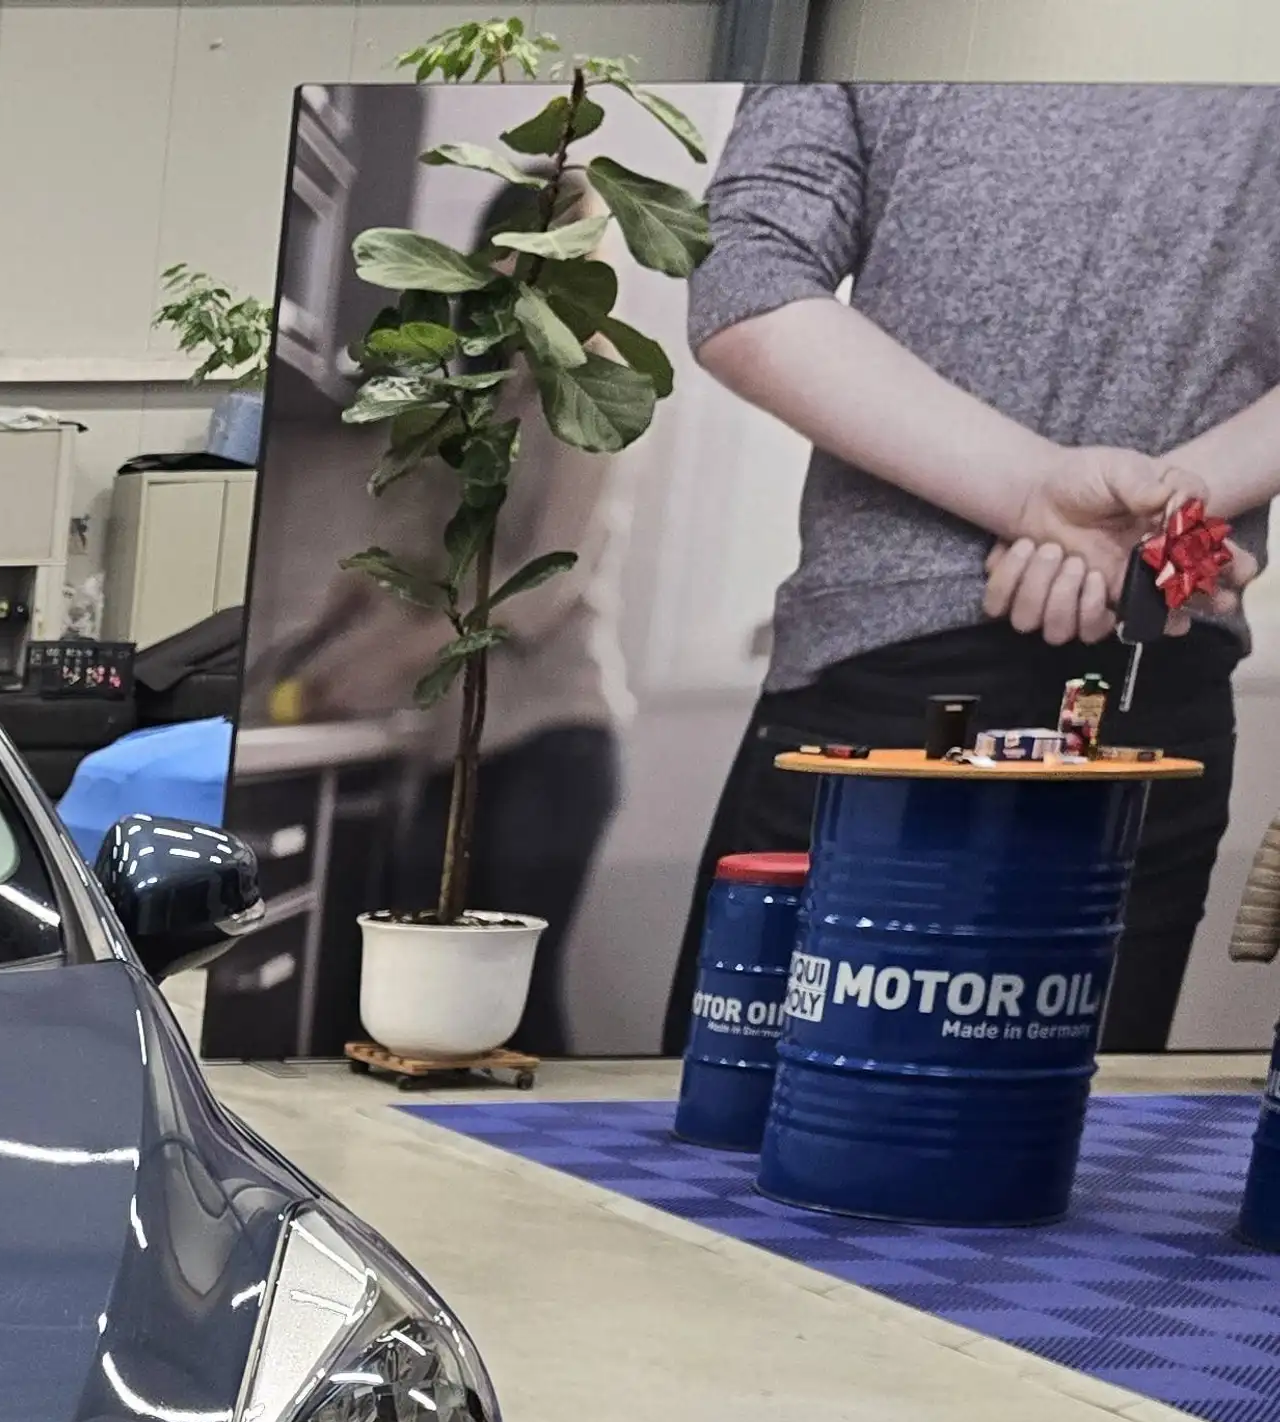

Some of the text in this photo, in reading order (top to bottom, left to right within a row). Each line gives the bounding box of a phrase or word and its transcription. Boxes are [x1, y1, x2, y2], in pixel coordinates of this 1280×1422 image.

[832, 960, 1100, 1017] MOTOR OIL
[941, 1019, 999, 1039] Made
[1003, 1021, 1022, 1039] in
